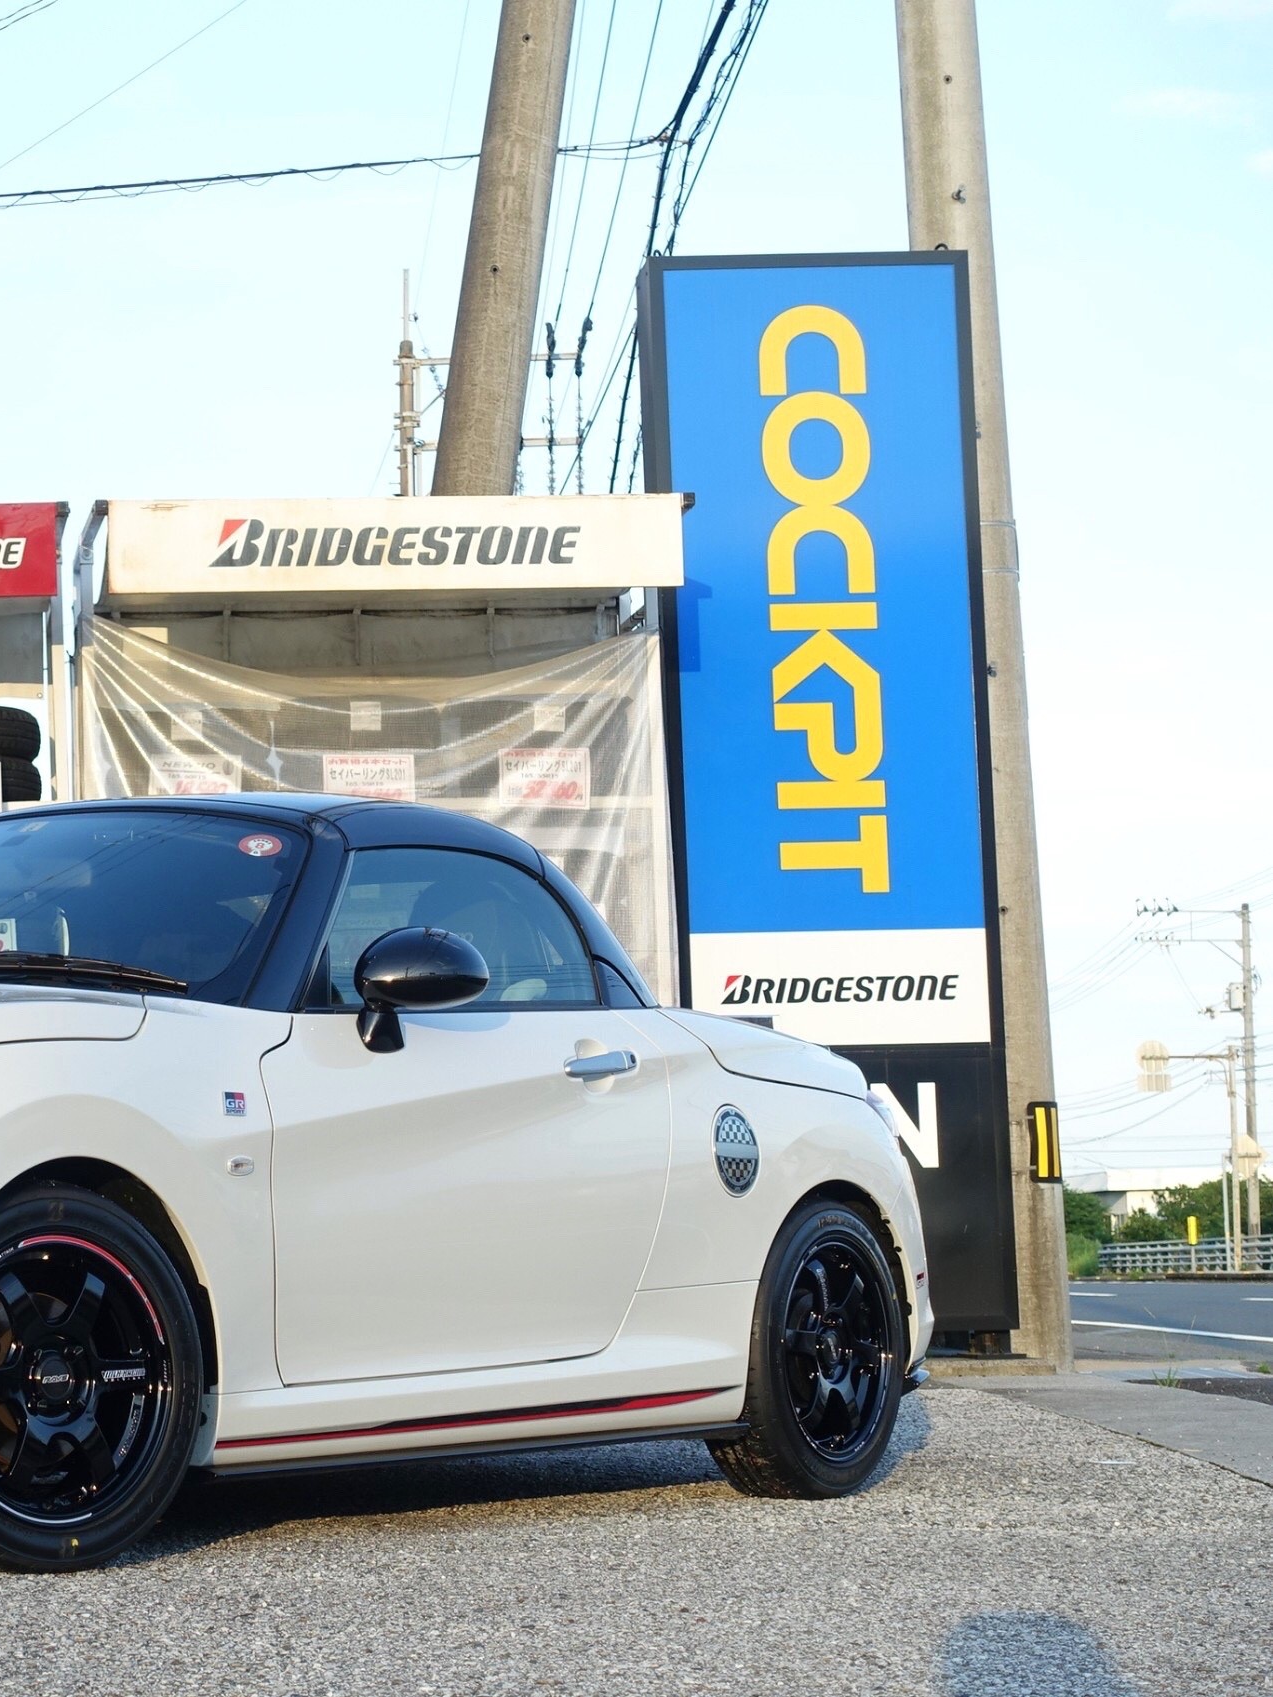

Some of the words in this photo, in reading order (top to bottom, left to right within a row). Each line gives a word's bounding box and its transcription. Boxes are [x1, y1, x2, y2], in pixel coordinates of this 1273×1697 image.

[208, 519, 581, 567] BRIDGESTONE
[759, 304, 890, 893] COCKPIT
[721, 974, 959, 1005] BRIDGESTONE
[226, 1098, 244, 1108] GR
[42, 1374, 69, 1384] RAYS
